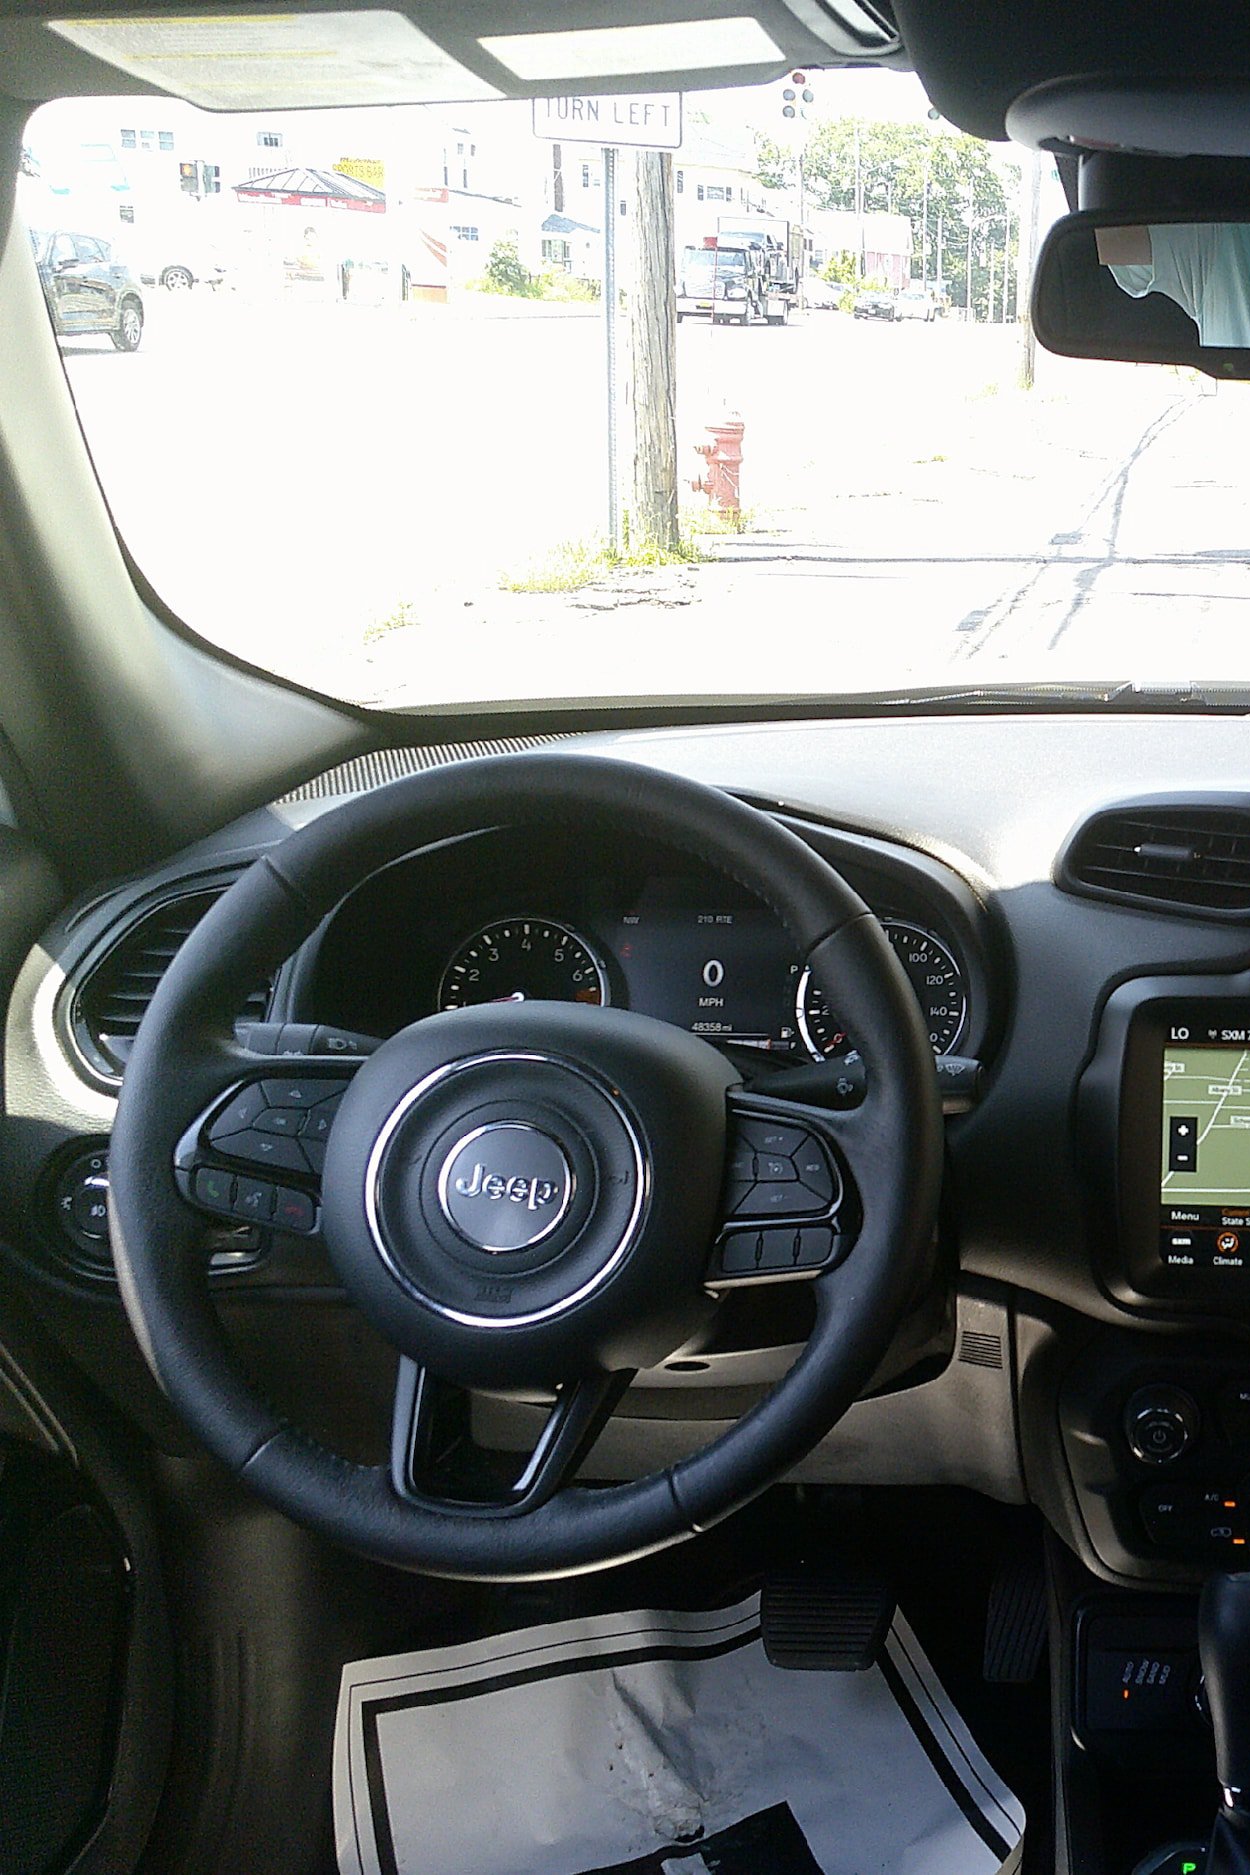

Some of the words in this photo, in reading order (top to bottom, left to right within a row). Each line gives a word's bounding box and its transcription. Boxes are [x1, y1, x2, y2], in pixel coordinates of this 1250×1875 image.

[613, 101, 670, 126] LEFT
[520, 938, 532, 951] 4
[488, 947, 500, 961] 3
[554, 948, 565, 962] 5
[908, 952, 928, 963] 100
[468, 968, 480, 982] 2
[572, 969, 584, 982] 6
[702, 958, 725, 988] 0
[790, 965, 799, 975] P
[925, 974, 944, 985] 120
[698, 997, 725, 1008] MPH
[929, 1006, 948, 1017] 140
[1170, 1026, 1190, 1040] LO
[1220, 1029, 1246, 1041] SXM
[455, 1162, 560, 1212] Jeep
[1170, 1210, 1200, 1222] Menu
[1221, 1216, 1245, 1226] State
[1167, 1255, 1194, 1266] Media
[1212, 1256, 1244, 1266] Climate
[1182, 1862, 1197, 1875] P
